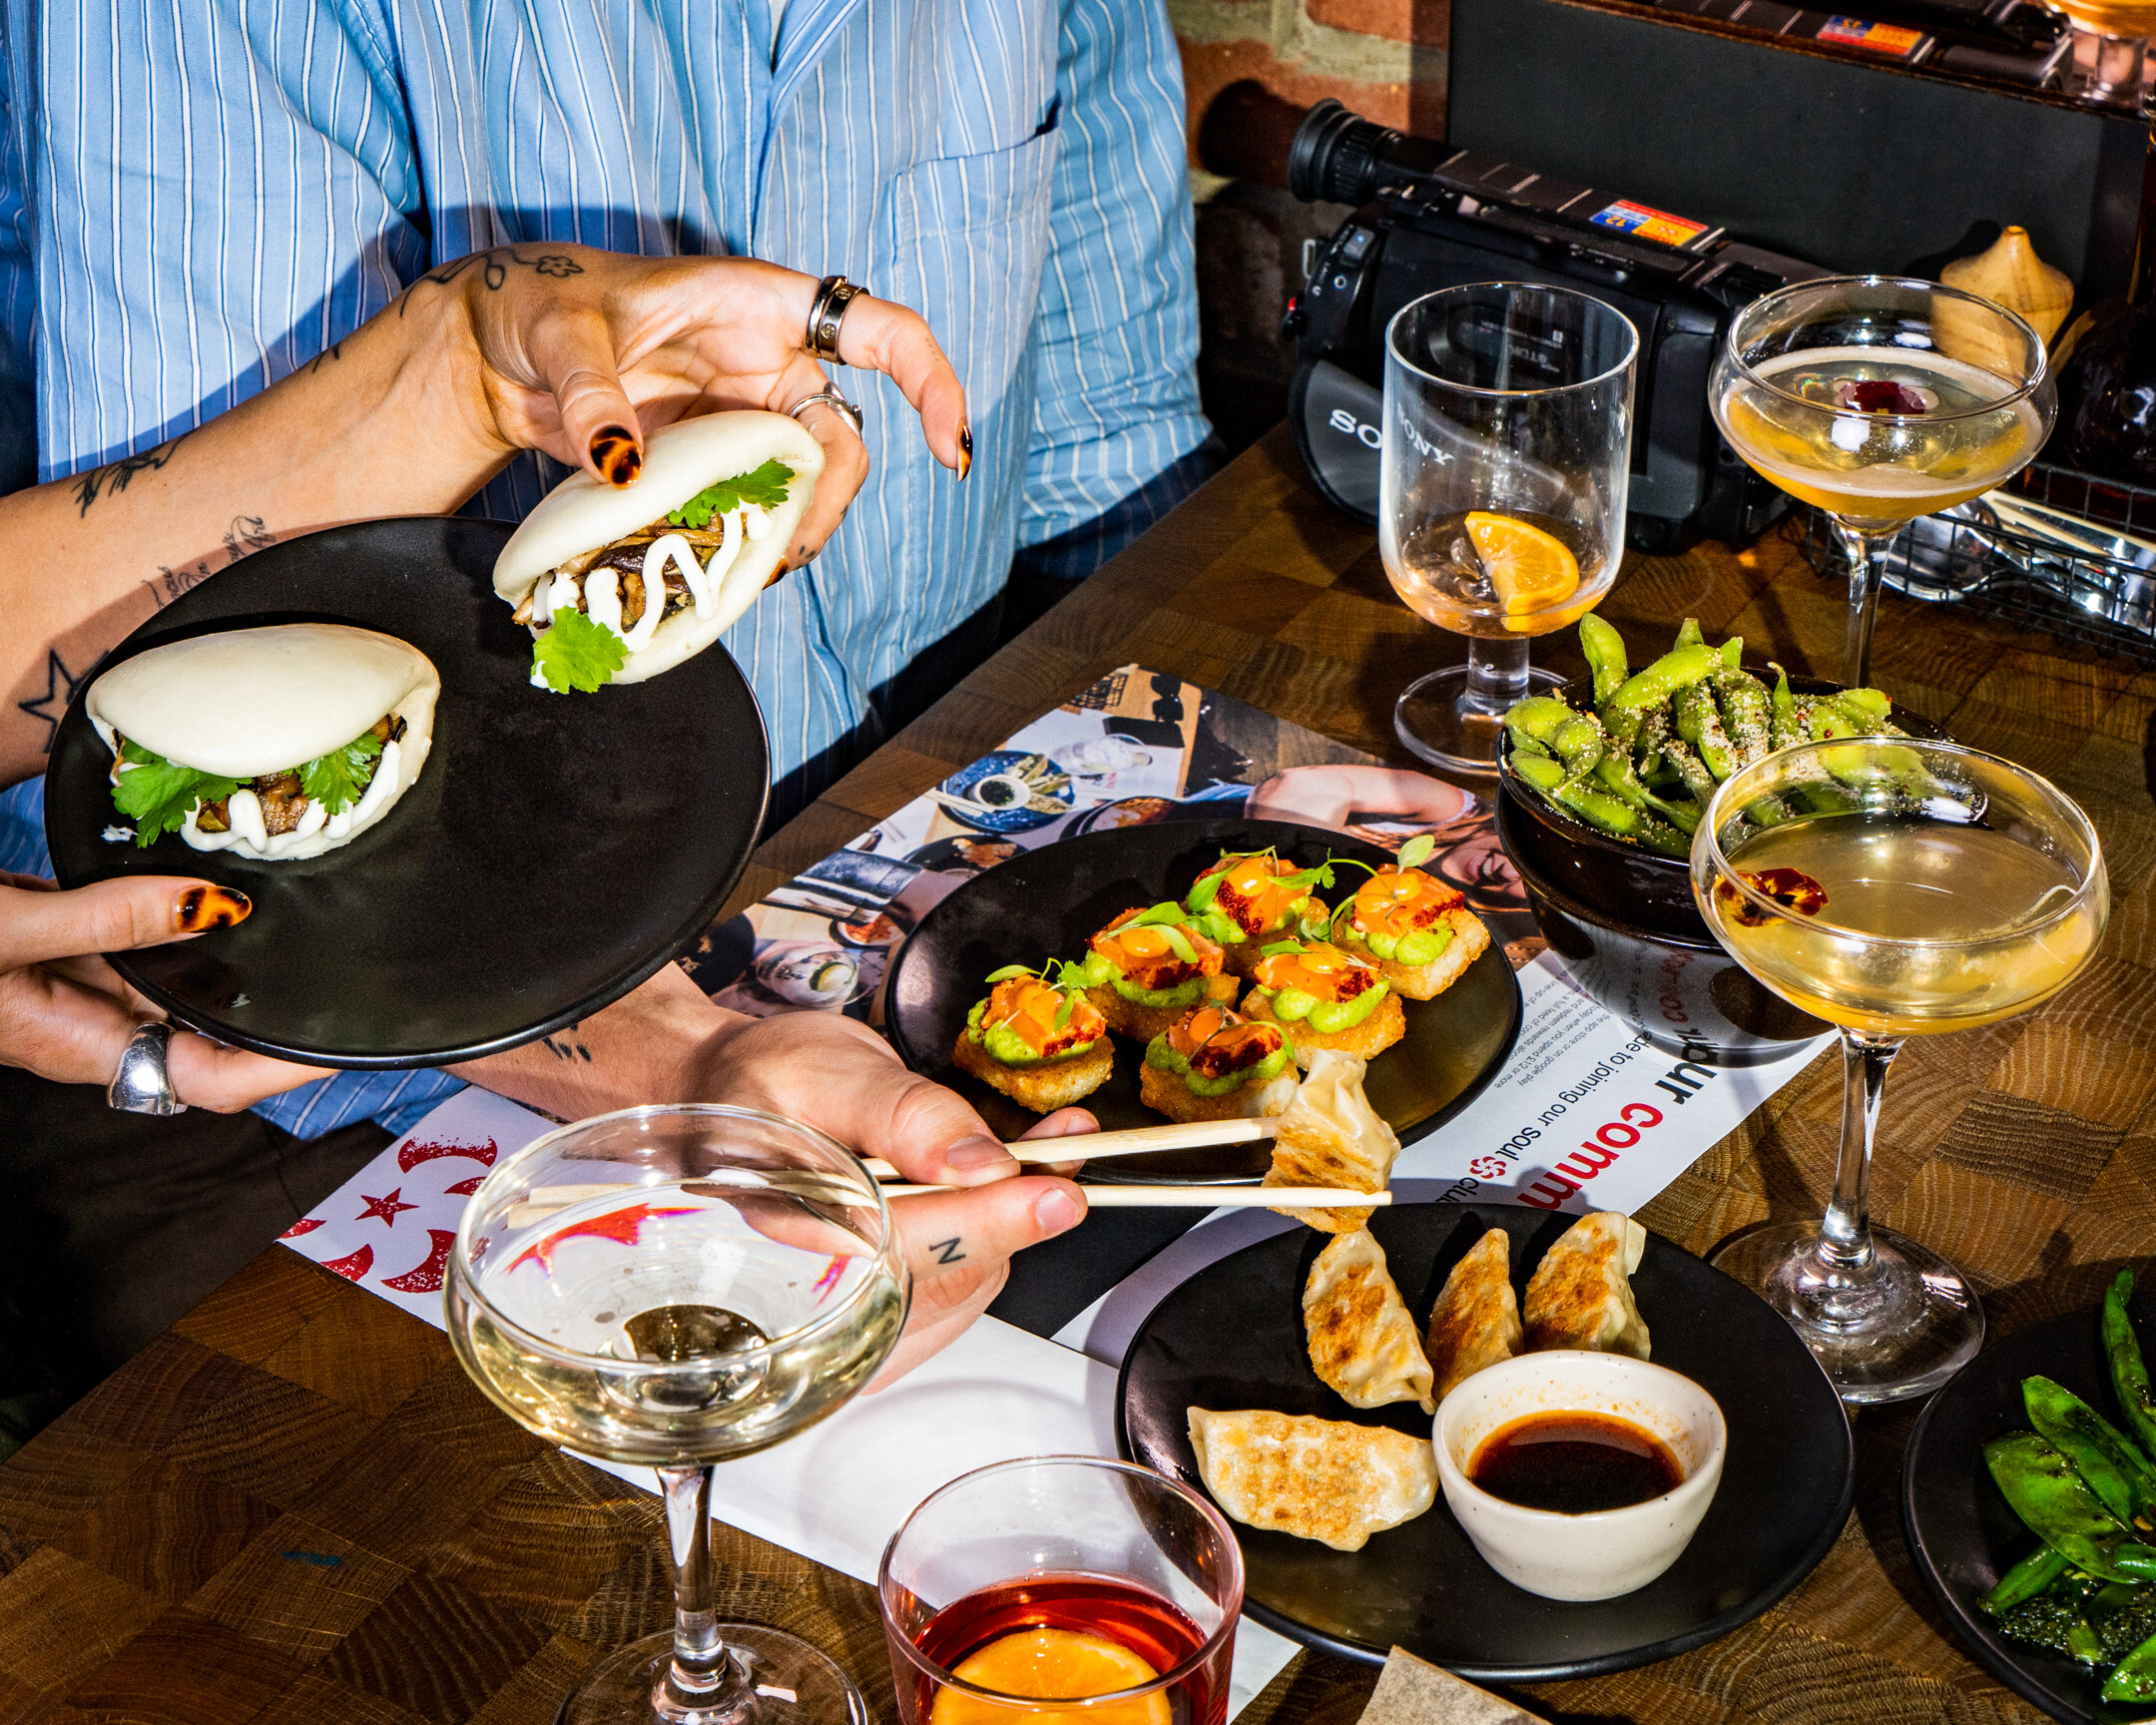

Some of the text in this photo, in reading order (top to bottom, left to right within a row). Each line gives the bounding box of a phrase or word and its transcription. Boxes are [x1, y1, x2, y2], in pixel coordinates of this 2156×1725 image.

[1551, 1030, 1565, 1042] you
[1532, 1040, 1554, 1057] spend
[1532, 1055, 1555, 1075] google
[1610, 1051, 1634, 1065] to
[1494, 1074, 1512, 1088] more
[1516, 1073, 1534, 1086] play
[1558, 1061, 1619, 1104] joining
[1537, 1103, 1567, 1126] our
[1494, 1126, 1542, 1161] soul
